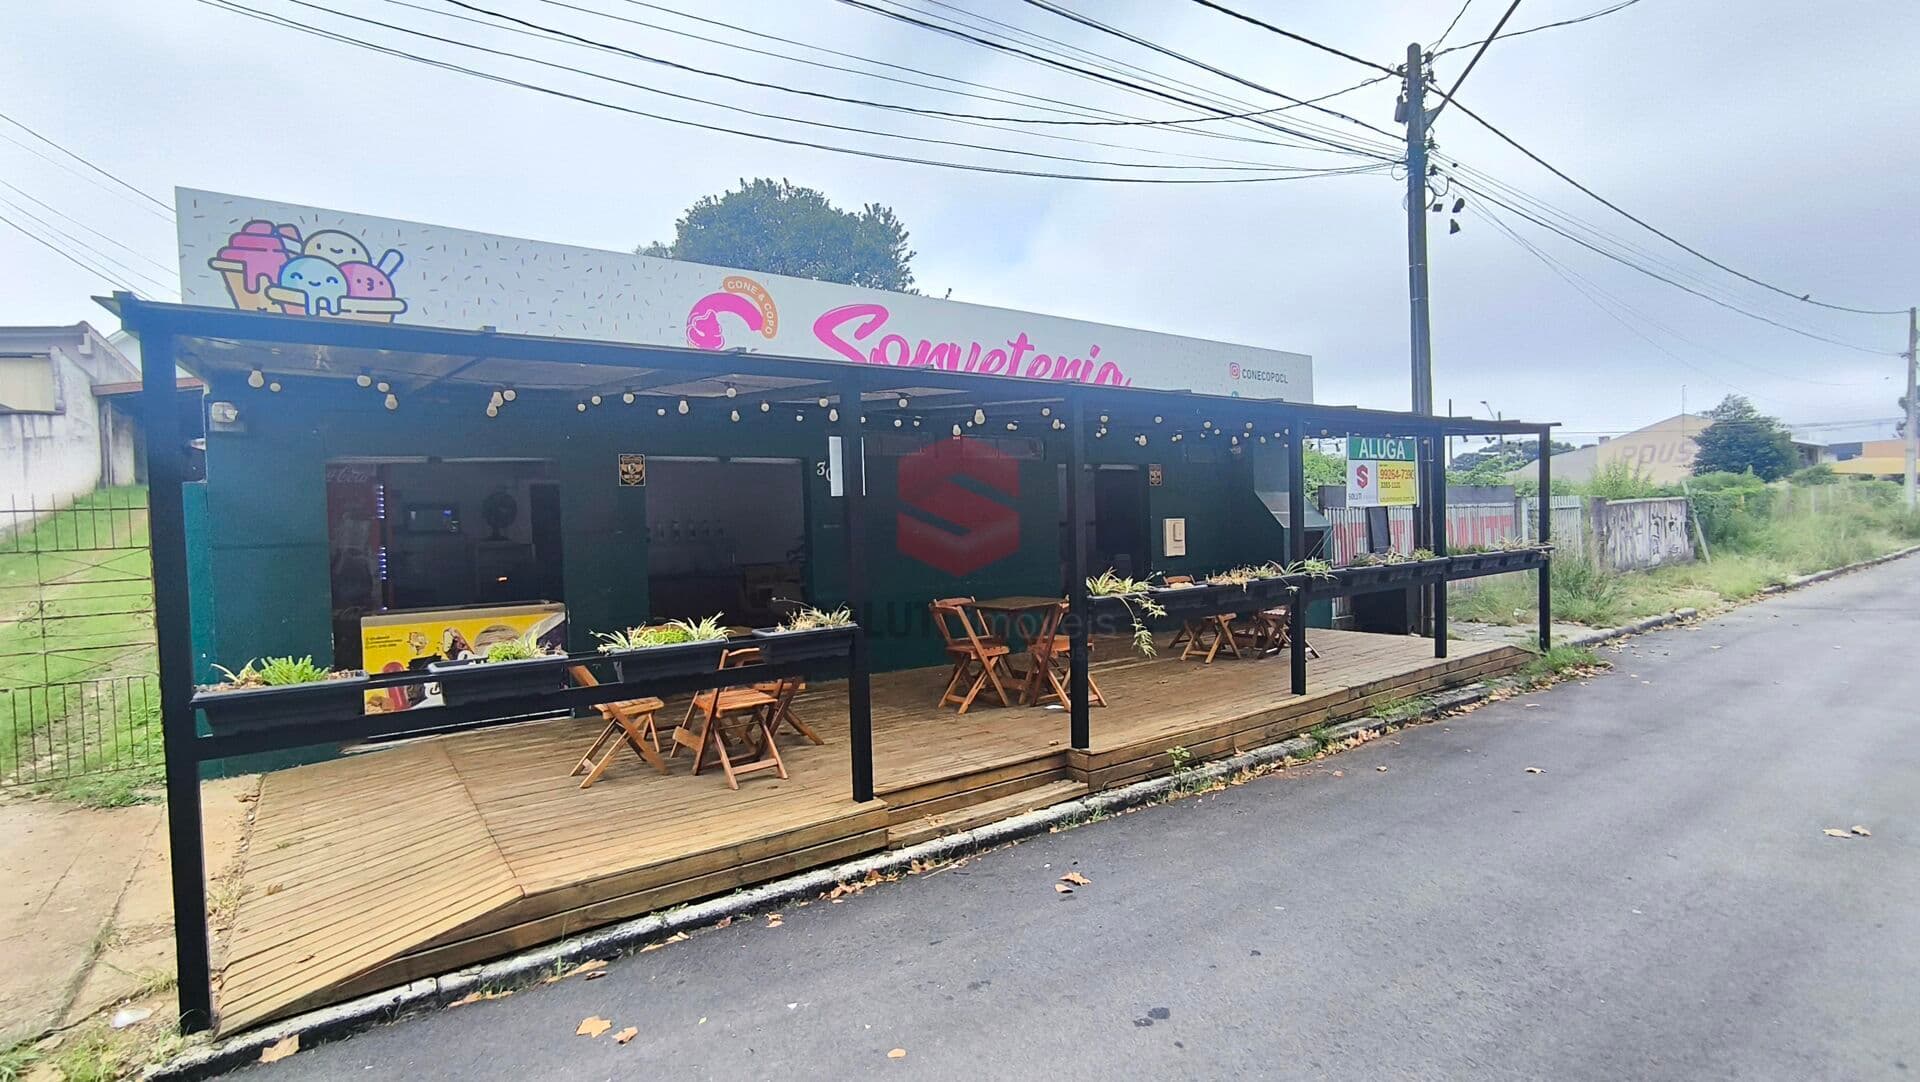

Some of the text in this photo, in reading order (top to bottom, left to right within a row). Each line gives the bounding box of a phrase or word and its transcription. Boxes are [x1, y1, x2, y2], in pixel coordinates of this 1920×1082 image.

[727, 280, 759, 295] CONE
[763, 303, 774, 335] COPO
[1359, 438, 1406, 460] ALUGA
